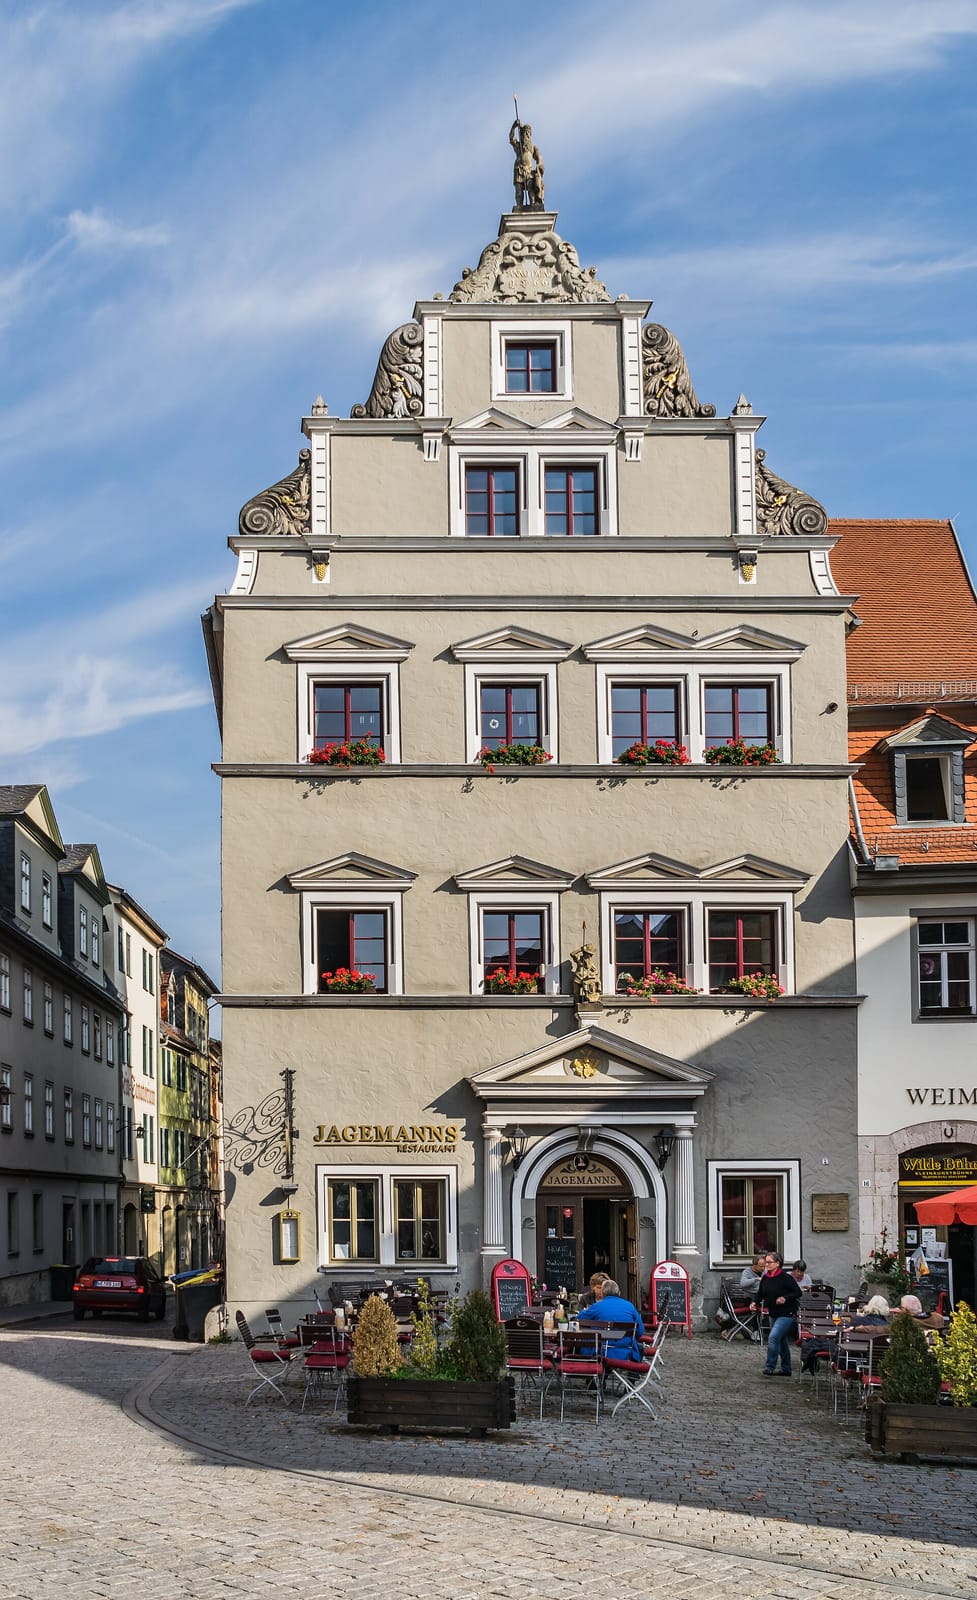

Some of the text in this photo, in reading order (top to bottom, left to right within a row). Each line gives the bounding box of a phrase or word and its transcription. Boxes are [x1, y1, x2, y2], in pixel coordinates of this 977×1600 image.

[905, 1087, 977, 1105] WEIM
[312, 1125, 459, 1143] JAGEMANNS
[396, 1144, 456, 1153] RESTAURANT
[902, 1157, 941, 1171] Wilde
[547, 1175, 617, 1185] JAGEMANNS
